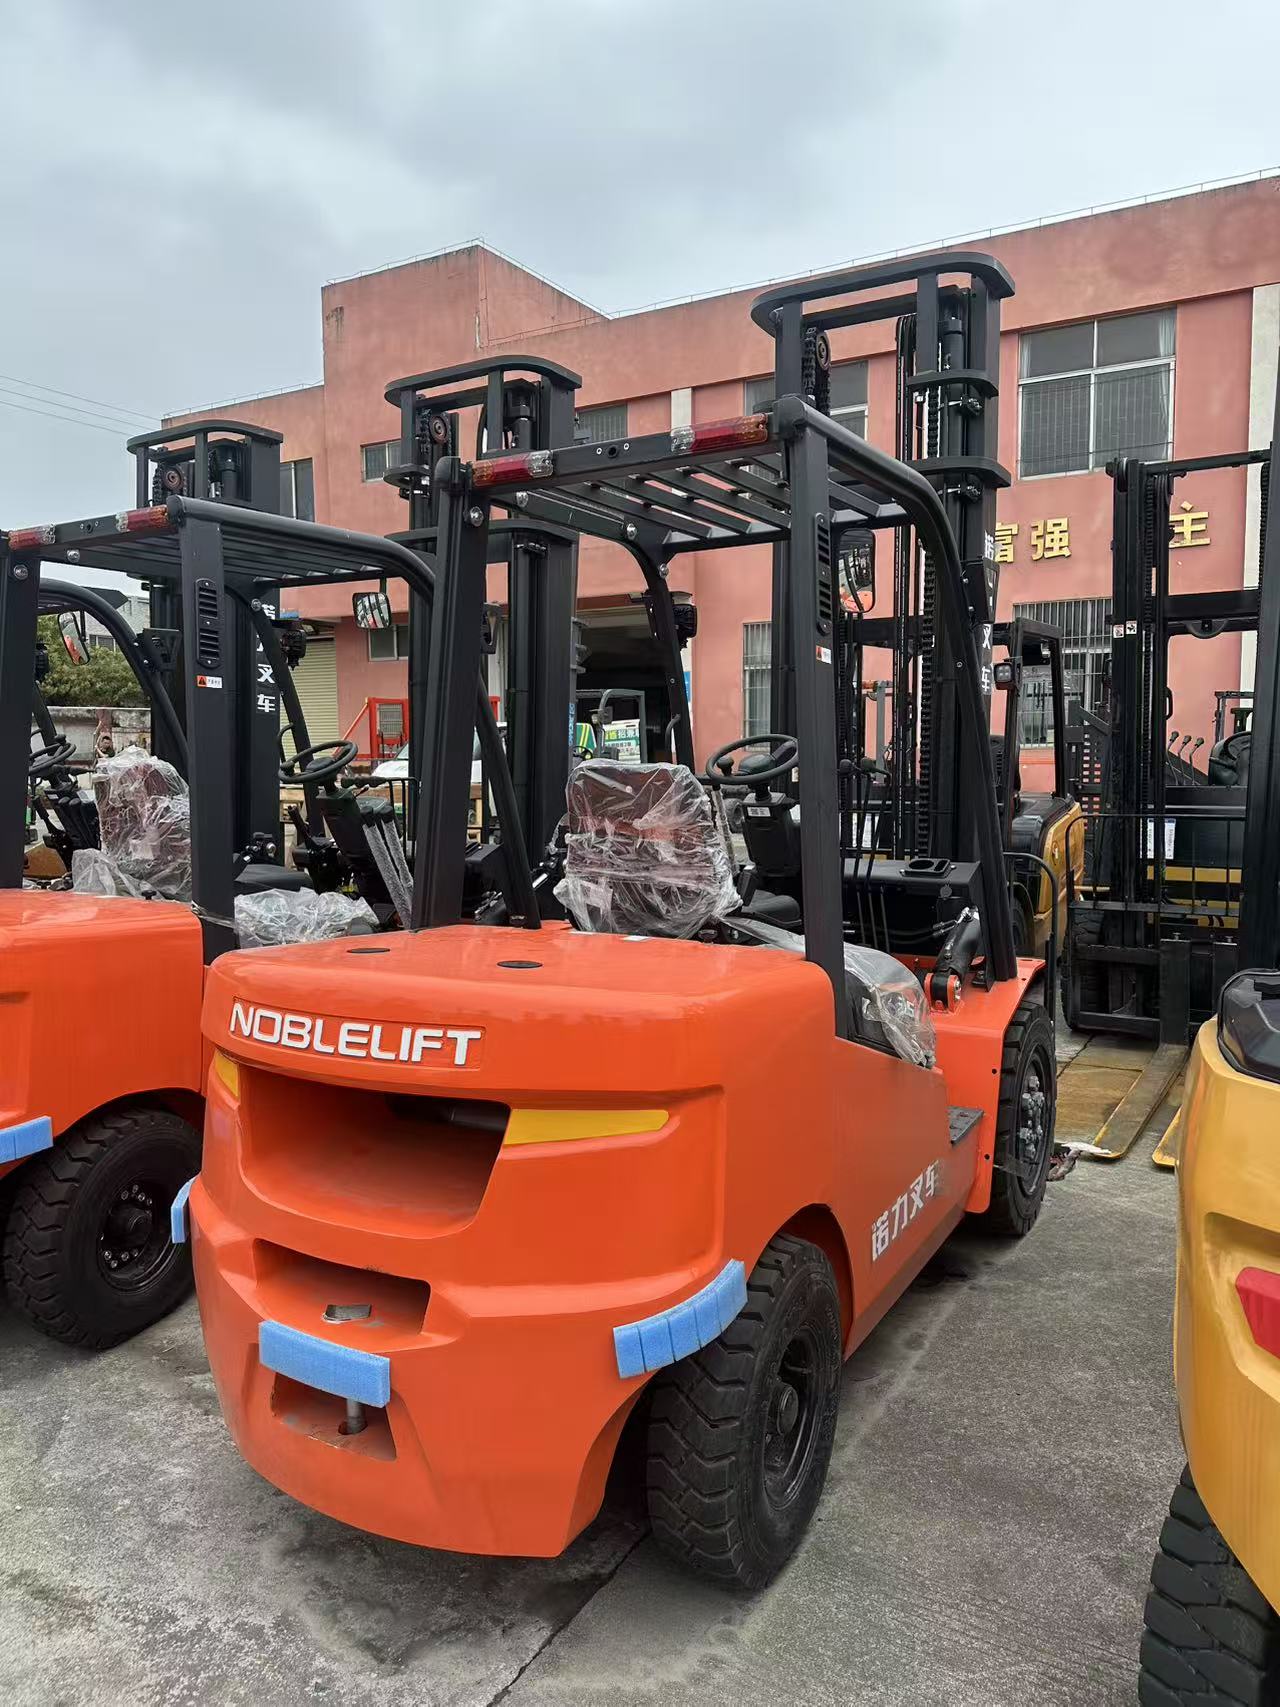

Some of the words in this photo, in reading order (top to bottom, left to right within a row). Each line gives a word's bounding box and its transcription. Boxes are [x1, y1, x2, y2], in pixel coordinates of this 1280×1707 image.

[981, 529, 996, 692] 诺叉车
[229, 1002, 482, 1066] NOBLELIFT
[872, 1160, 939, 1262] 诺力叉车
